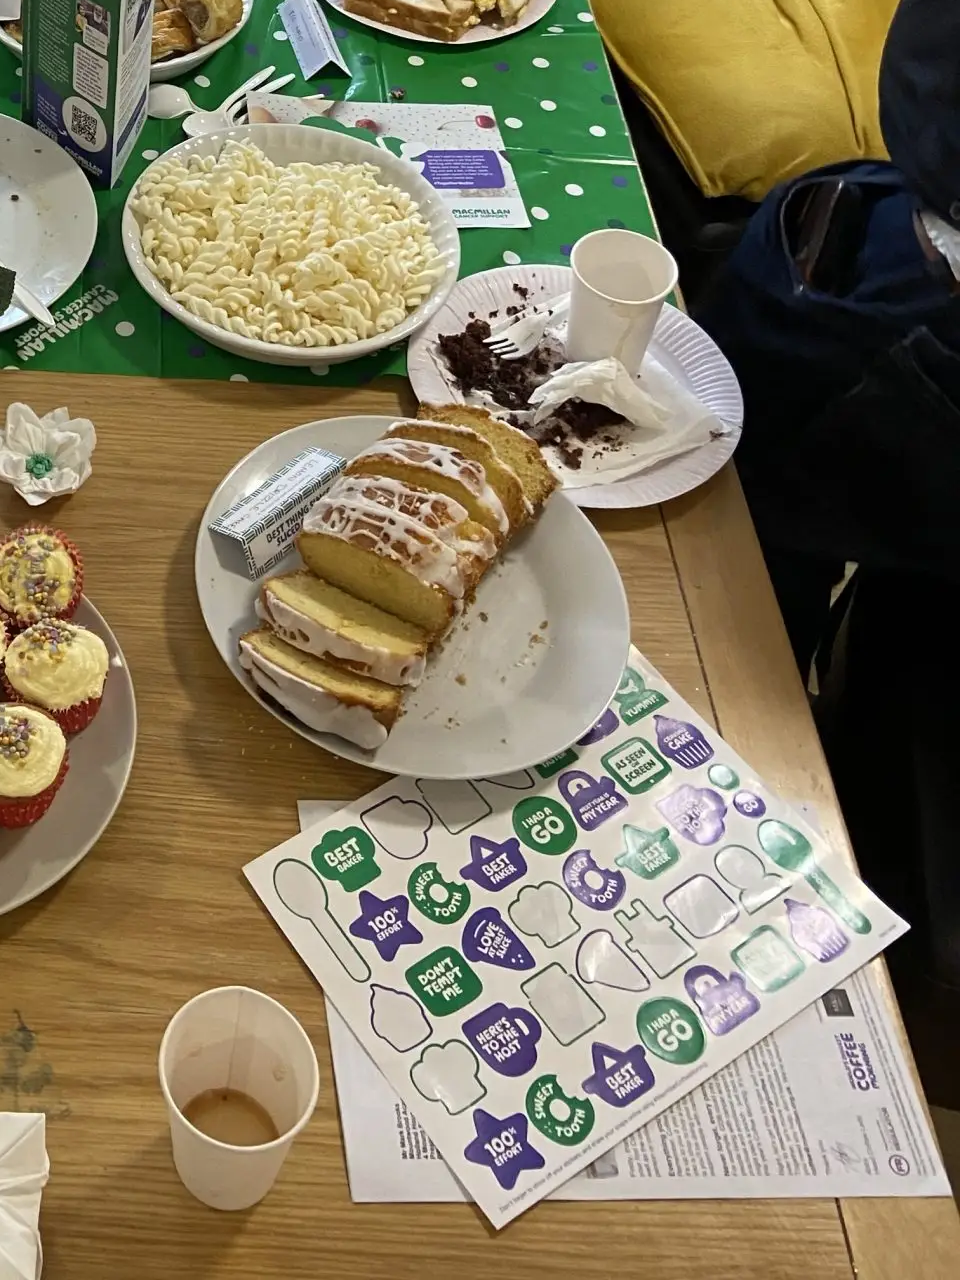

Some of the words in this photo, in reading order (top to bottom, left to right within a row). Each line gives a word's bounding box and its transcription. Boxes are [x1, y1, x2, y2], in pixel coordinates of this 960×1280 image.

[60, 284, 107, 316] CANCER
[17, 289, 119, 361] MACMILLAN
[266, 525, 285, 543] BEST
[283, 506, 310, 528] THING
[276, 523, 302, 546] SLICED
[668, 732, 694, 750] CAKE
[615, 759, 627, 770] AS
[625, 747, 647, 764] SEEN
[625, 759, 656, 782] SCREEN
[527, 810, 545, 824] HAD
[543, 807, 553, 816] A
[581, 807, 597, 824] MY
[595, 796, 620, 816] YEAR
[590, 797, 603, 810] YEAR
[744, 799, 758, 813] GO
[531, 815, 565, 844] GO
[323, 837, 359, 868] BEST
[337, 852, 365, 873] BAKER
[481, 853, 510, 878] BEST
[638, 841, 664, 865] BEST
[644, 852, 672, 873] FAKER
[489, 864, 518, 886] FAKER
[571, 856, 589, 888] SWEET
[415, 869, 434, 902] SWEET
[590, 878, 618, 904] TOOTH
[433, 892, 463, 918] TOOTH
[367, 906, 399, 933] 100%
[376, 920, 404, 942] EFFORT
[477, 921, 500, 954] LOVE
[491, 928, 506, 949] FIRST
[496, 936, 512, 960] SLICE
[487, 945, 497, 958] AT
[417, 956, 454, 986] DON'T
[423, 966, 463, 998] TEMPT
[442, 983, 464, 1002] ME
[476, 1016, 511, 1045] HERE'S
[651, 1013, 671, 1030] HAD
[669, 1008, 680, 1020] A
[482, 1040, 499, 1055] TO
[497, 1027, 520, 1046] THE
[657, 1020, 693, 1052] GO
[493, 1039, 522, 1063] HOST
[841, 1032, 870, 1092] COFFEE
[605, 1062, 634, 1090] BEST
[859, 1043, 880, 1089] MORNING
[613, 1075, 645, 1100] FAKER
[534, 1083, 555, 1120] SWEET
[555, 1107, 586, 1137] TOOTH
[484, 1127, 518, 1159] 100%
[495, 1142, 523, 1167] EFFORT
[661, 1134, 675, 1177] Everything
[720, 1153, 730, 1177] Never
